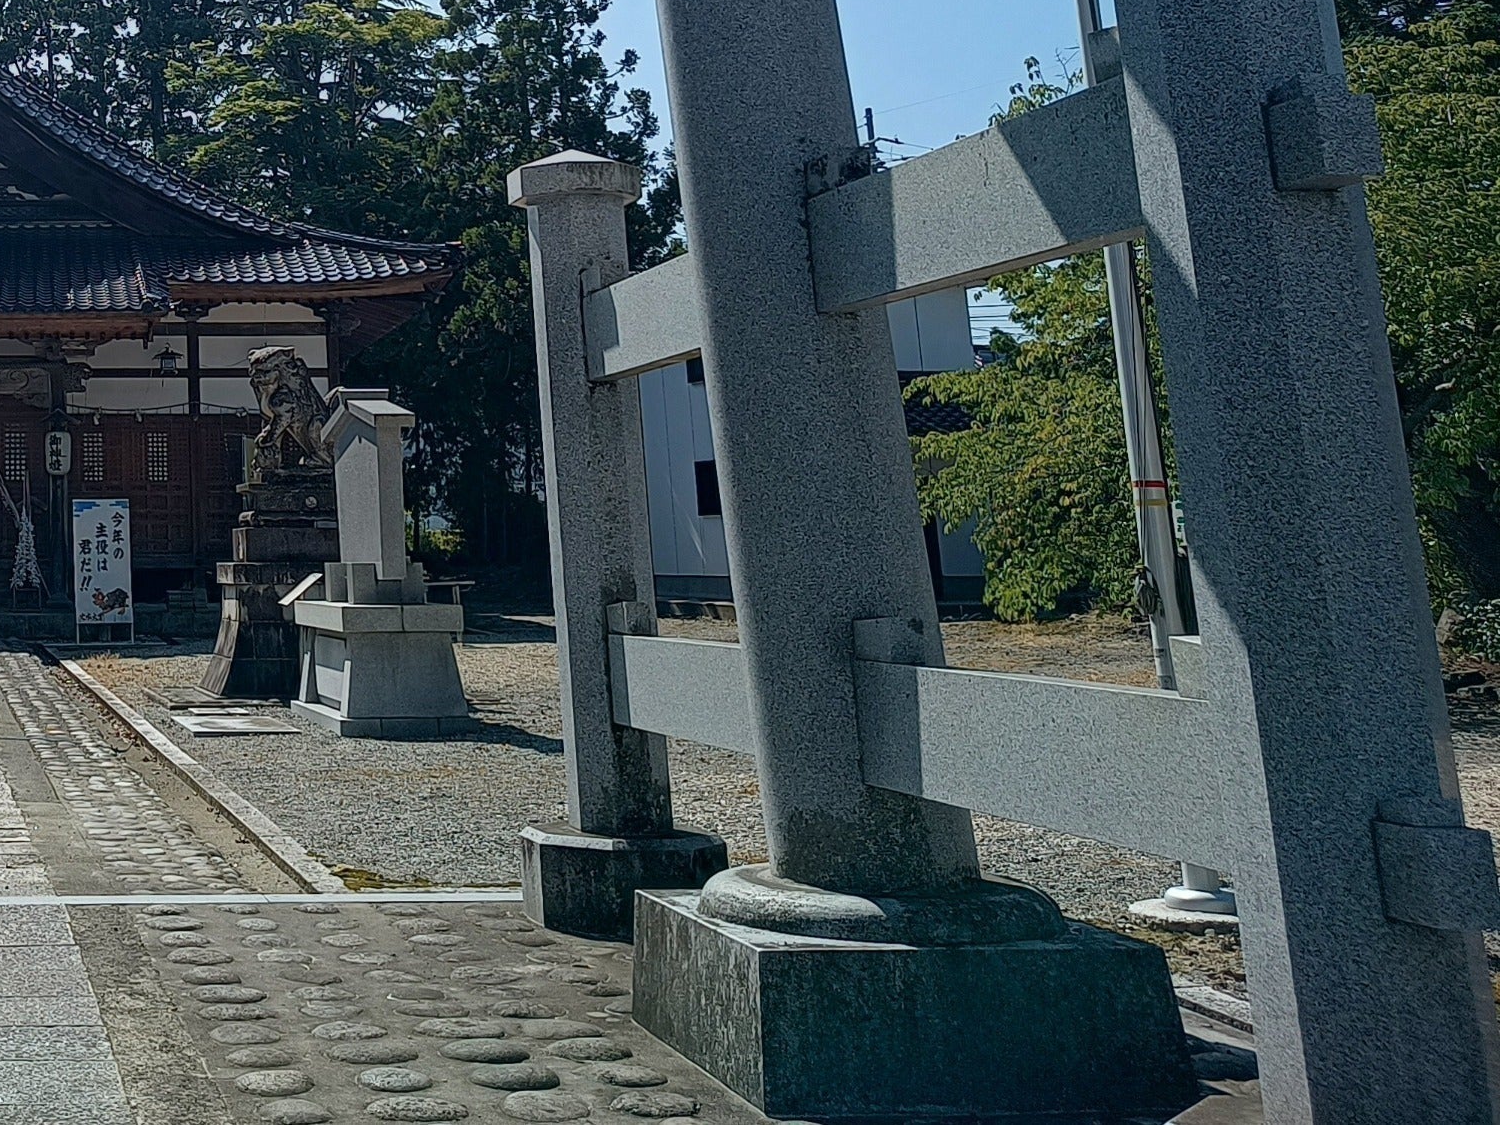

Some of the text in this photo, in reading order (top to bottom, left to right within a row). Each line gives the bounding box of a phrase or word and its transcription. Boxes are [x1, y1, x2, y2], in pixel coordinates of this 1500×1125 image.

[94, 522, 109, 573] 主役は
[111, 511, 125, 560] 今年の
[78, 539, 93, 592] 君だ!!
